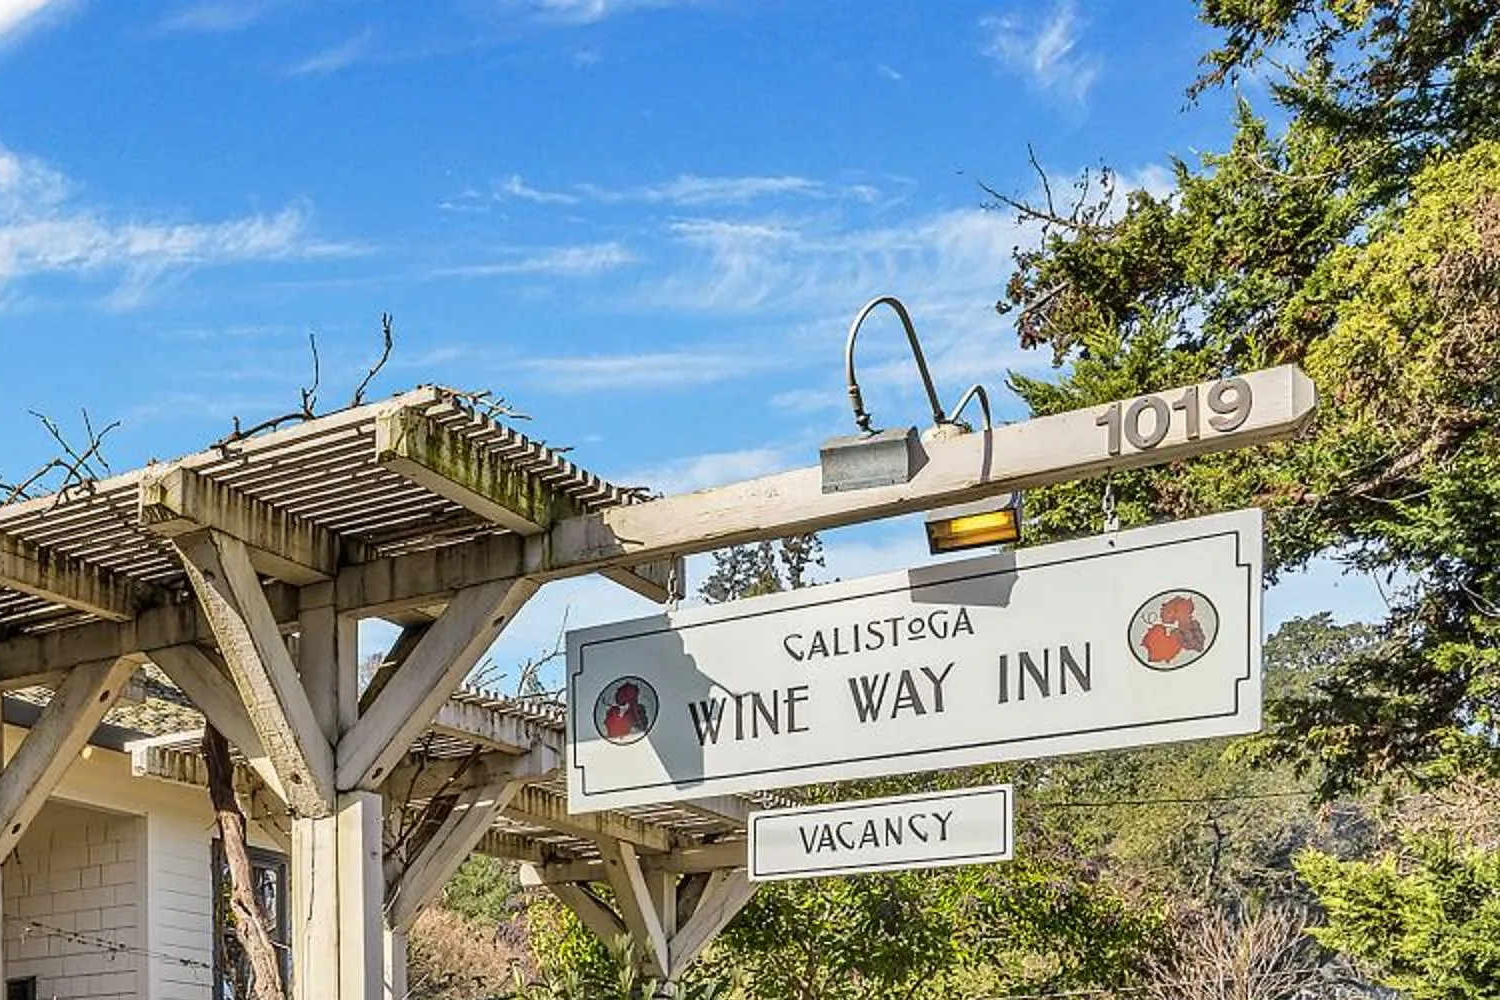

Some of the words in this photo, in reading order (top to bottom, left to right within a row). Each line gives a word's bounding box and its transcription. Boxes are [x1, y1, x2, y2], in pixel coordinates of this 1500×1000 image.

[1096, 378, 1253, 456] 1019
[688, 685, 809, 746] WINE
[848, 662, 955, 723] WAY
[998, 641, 1092, 704] INN
[799, 811, 953, 854] VACANCY
